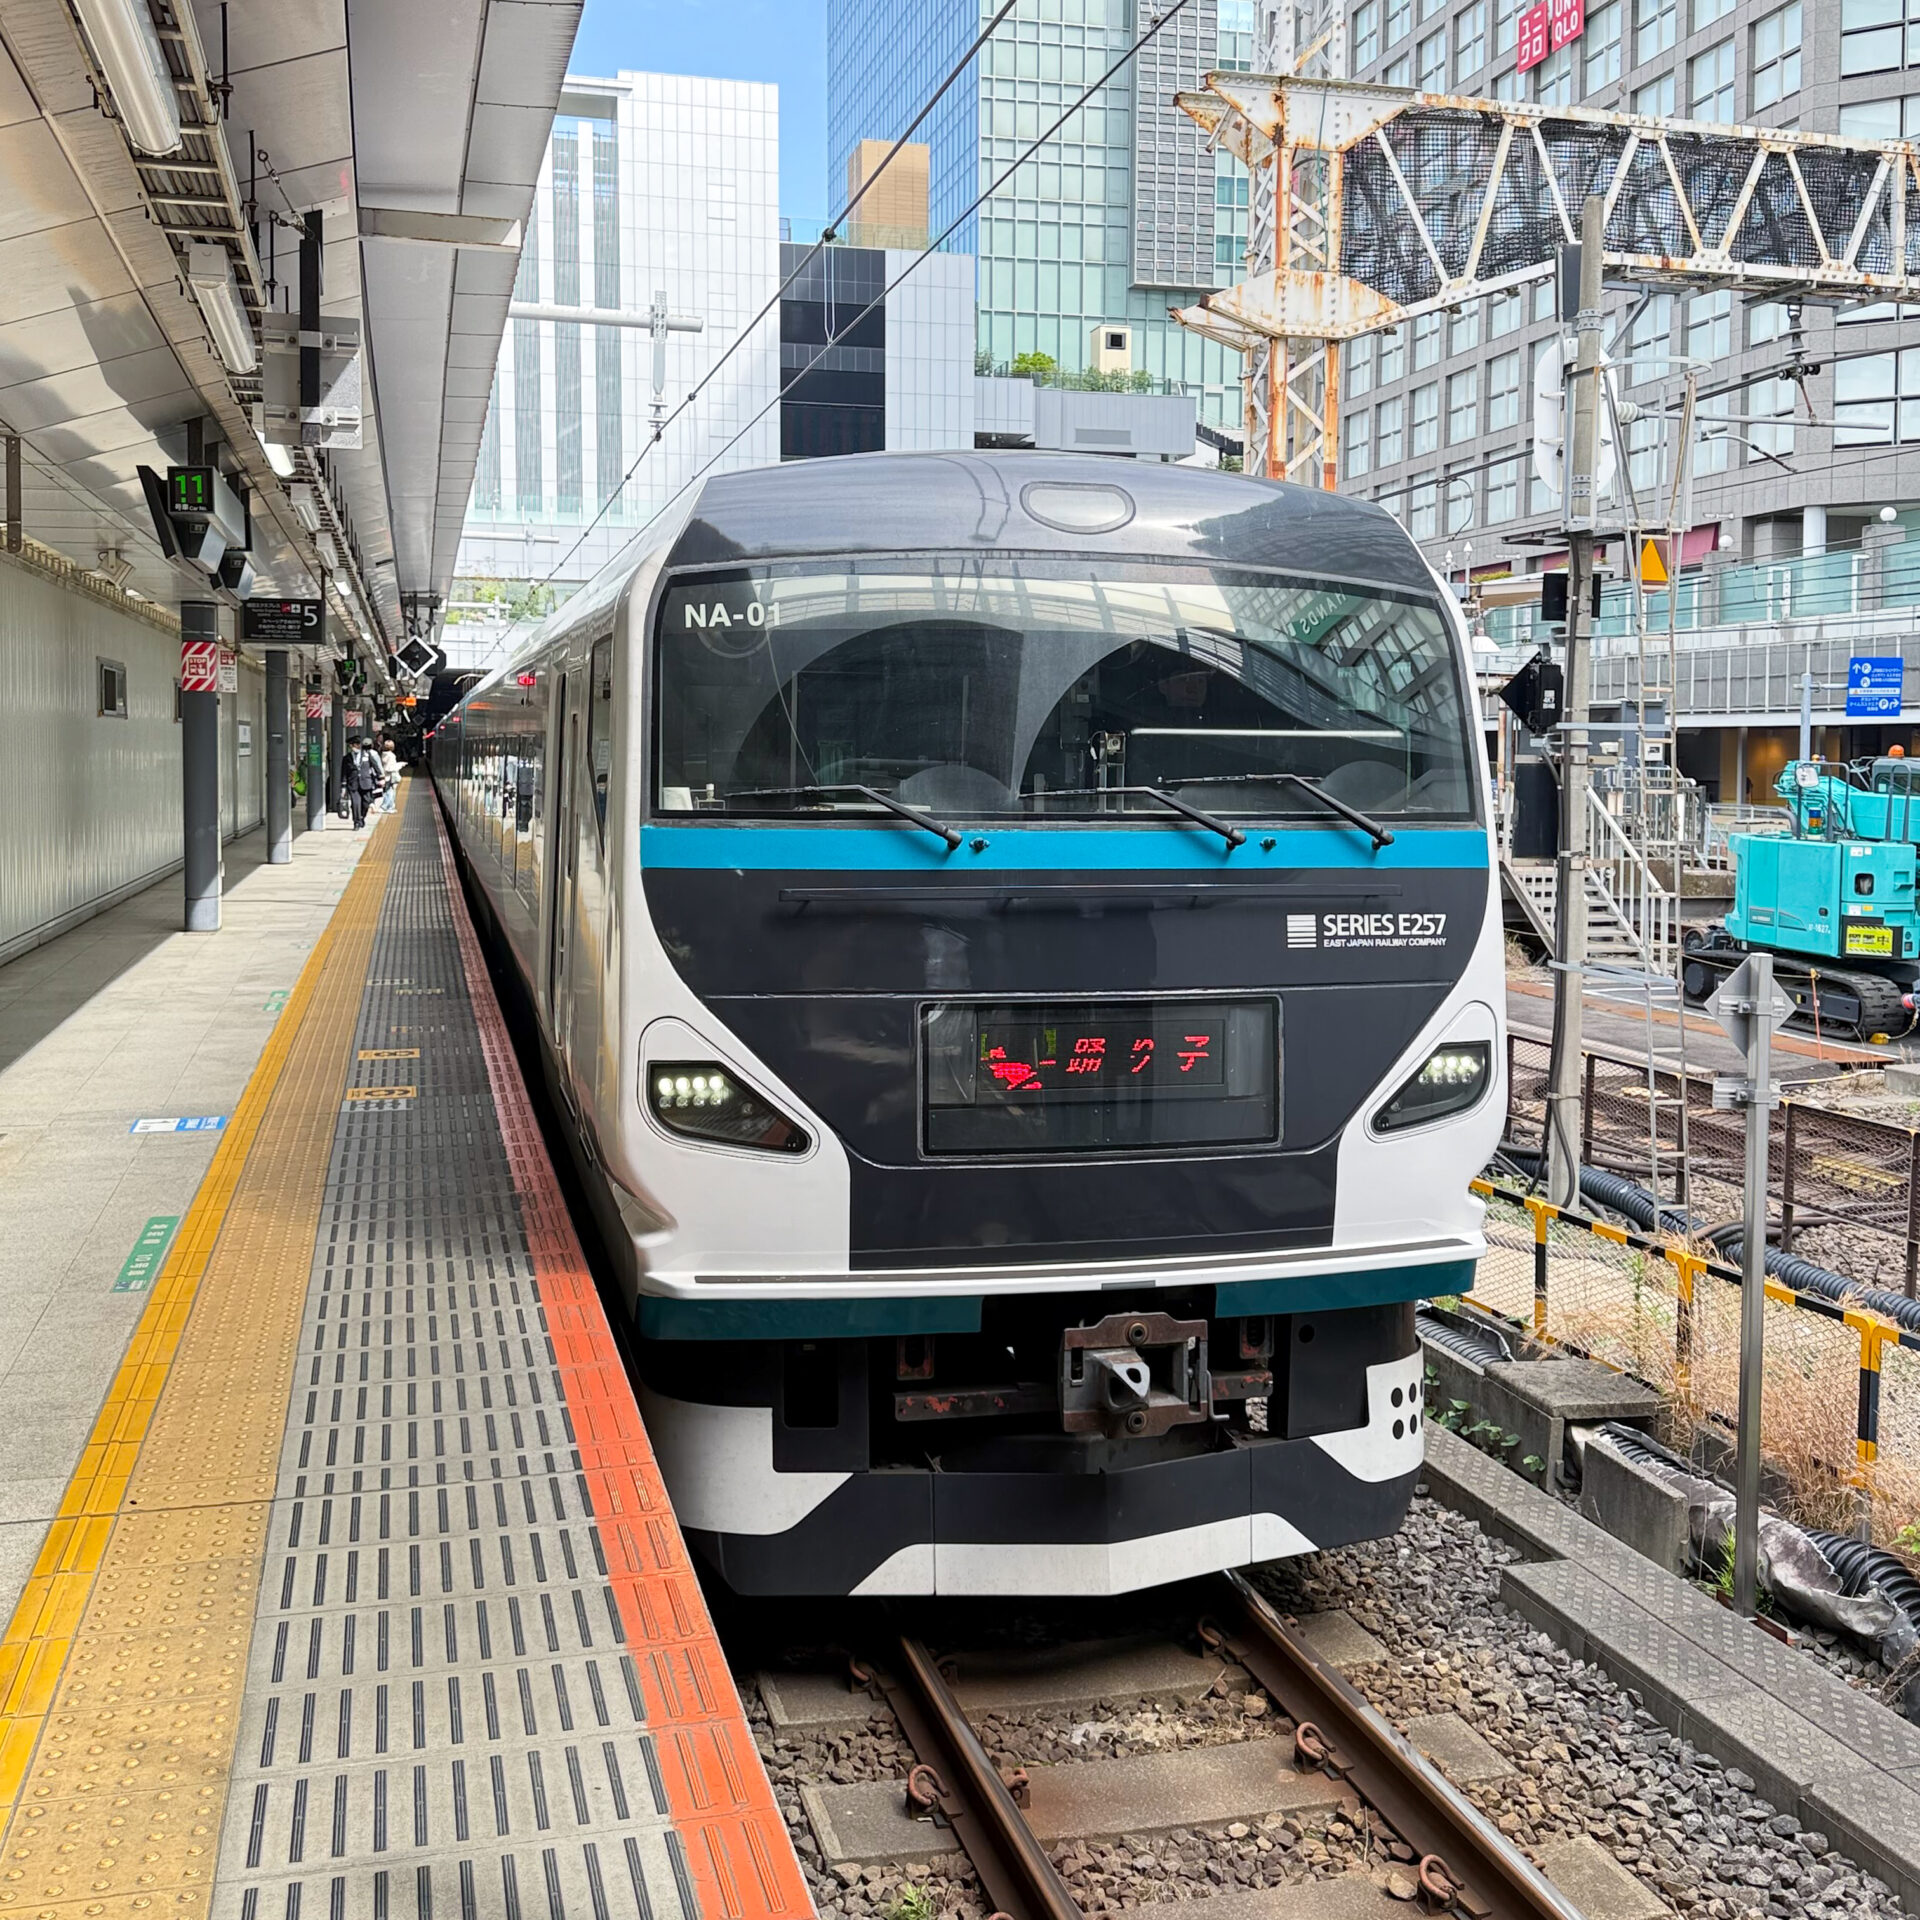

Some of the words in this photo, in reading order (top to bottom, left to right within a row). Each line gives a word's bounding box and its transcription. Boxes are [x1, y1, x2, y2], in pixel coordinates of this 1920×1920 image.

[1555, 10, 1578, 43] QLO
[175, 474, 203, 503] 11
[303, 605, 319, 627] 5
[685, 602, 781, 628] NA-01
[1323, 914, 1395, 936] SERIES
[1399, 914, 1446, 936] E257
[1324, 939, 1346, 947] EAST
[1347, 939, 1374, 947] JAPAN
[1375, 938, 1408, 947] RAILWAY
[1409, 938, 1447, 946] COMPANY
